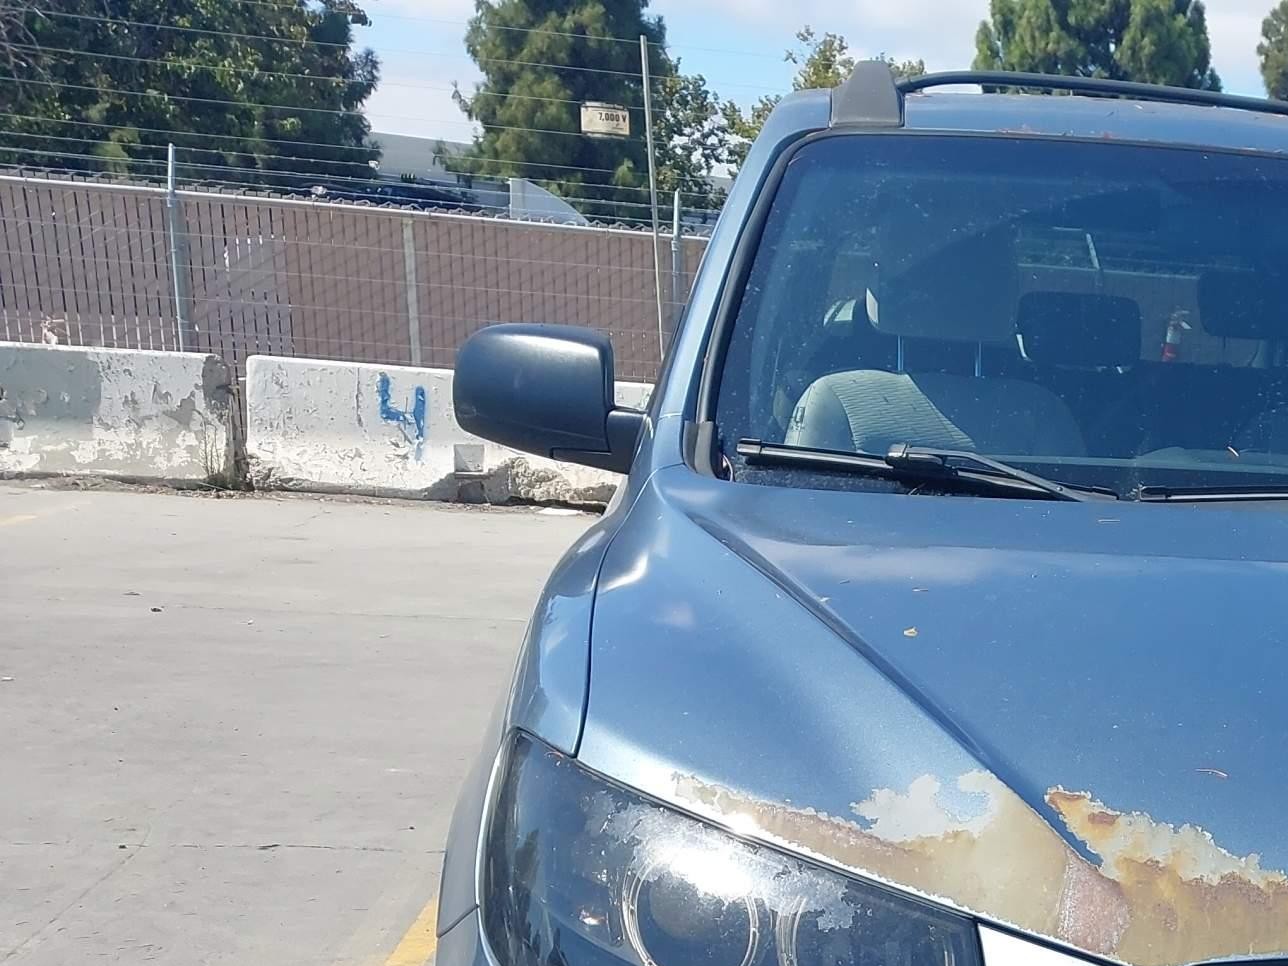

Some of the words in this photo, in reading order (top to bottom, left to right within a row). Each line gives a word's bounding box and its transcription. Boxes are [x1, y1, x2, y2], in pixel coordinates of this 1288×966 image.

[598, 111, 620, 122] 7,000
[621, 114, 627, 123] V
[377, 371, 426, 461] 4
